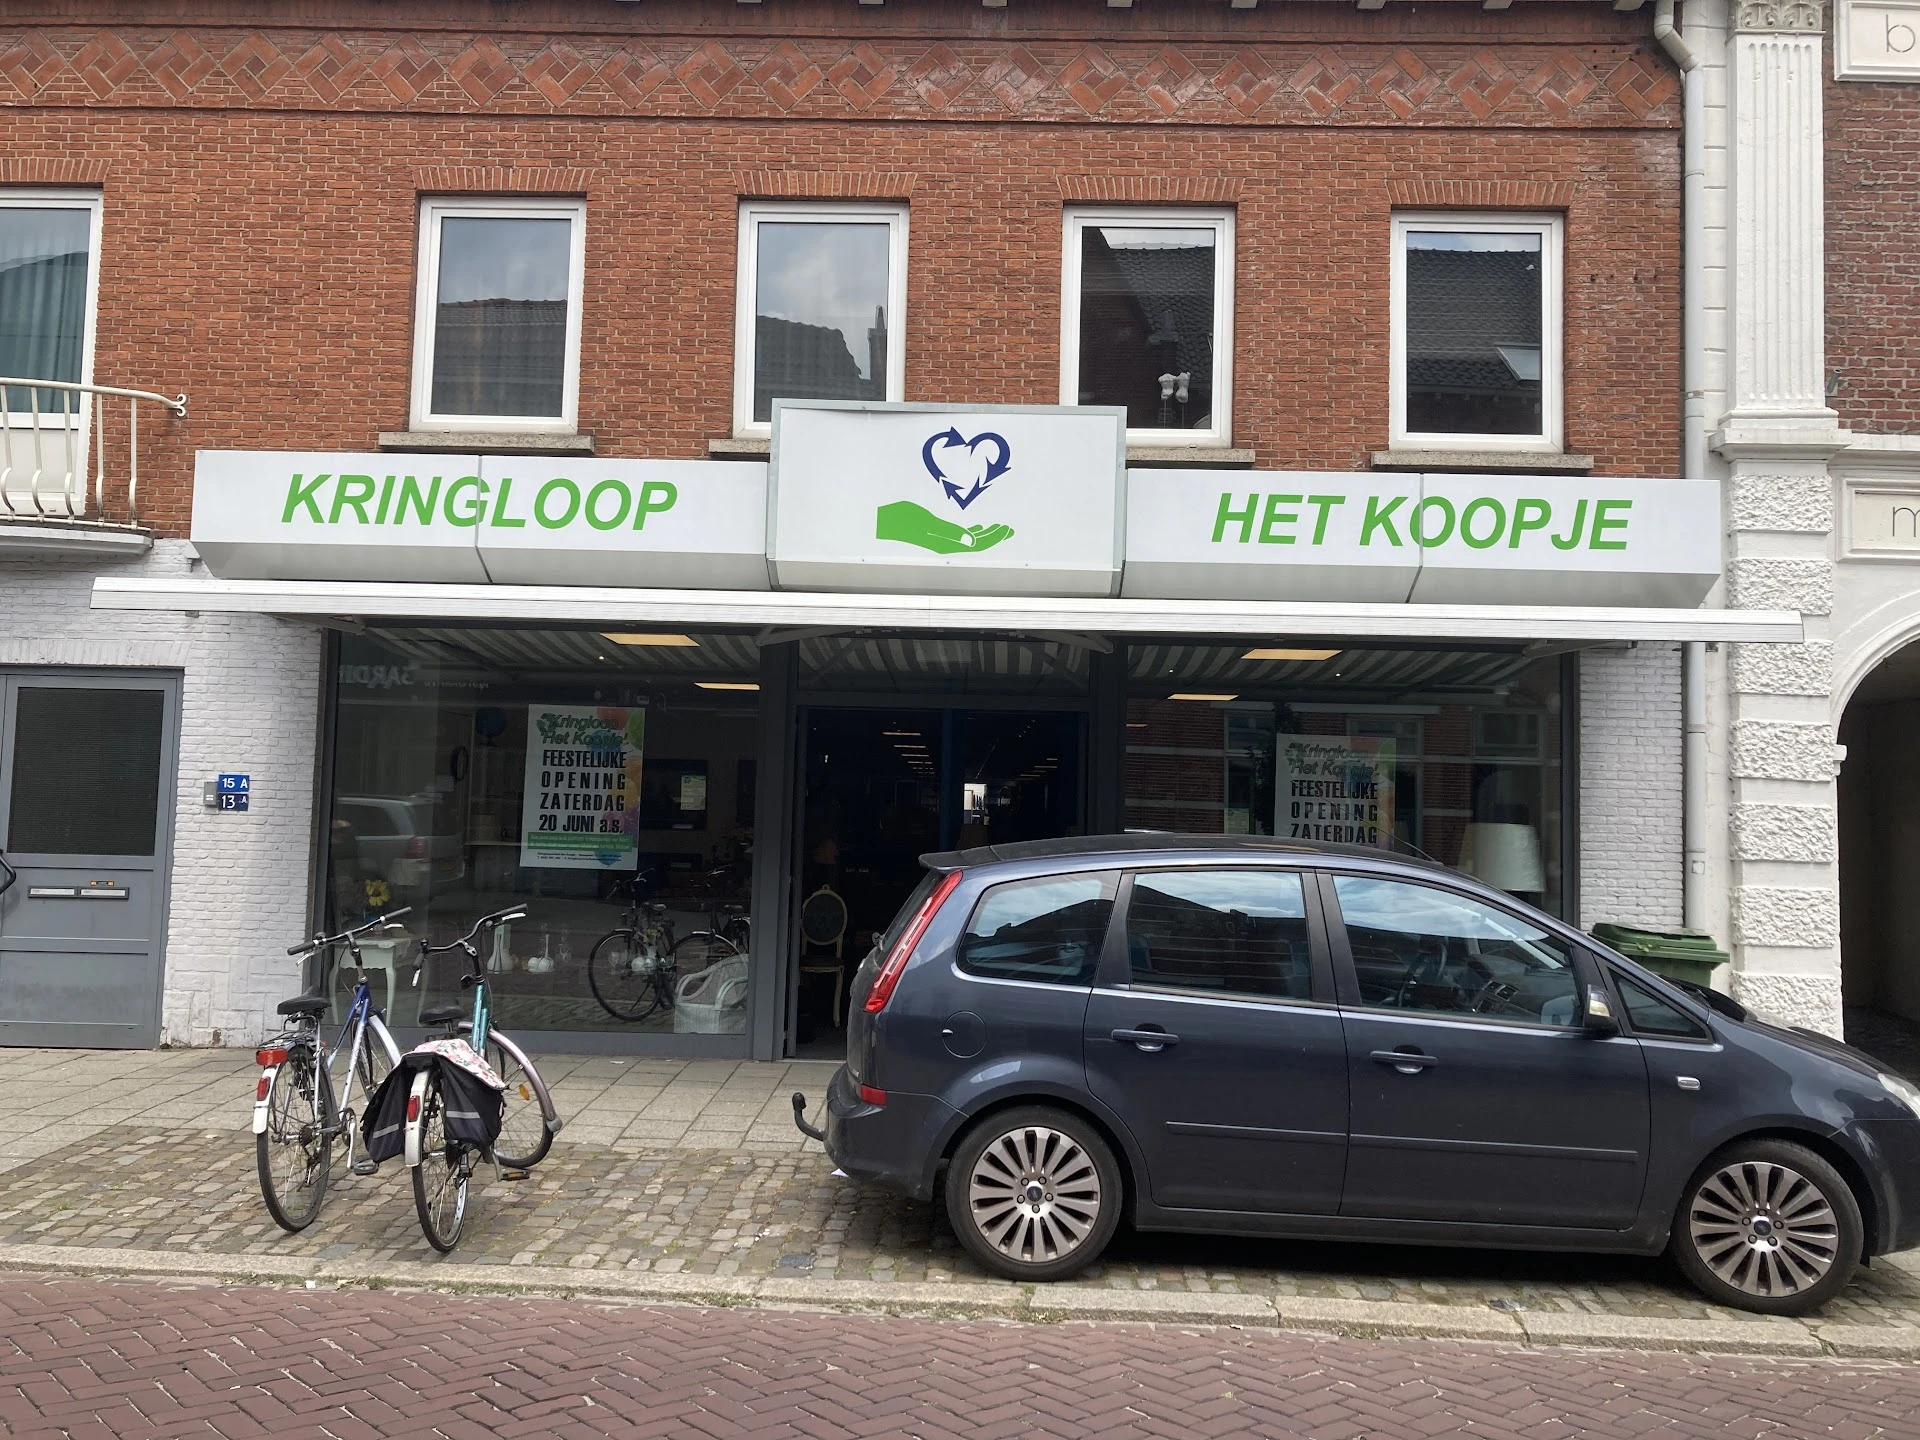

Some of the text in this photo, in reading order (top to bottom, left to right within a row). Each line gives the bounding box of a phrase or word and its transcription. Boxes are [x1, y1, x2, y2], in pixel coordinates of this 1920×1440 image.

[281, 473, 678, 531] KRINGLOOP
[1211, 492, 1633, 550] HET KOOPJE
[549, 714, 619, 732] Kringloop
[543, 750, 627, 768] FEESTELIJKE
[1298, 744, 1369, 762] Kringloop
[222, 778, 248, 788] 15 A
[541, 771, 626, 790] OPENING
[1291, 780, 1378, 800] FEESTELIJKE
[222, 795, 236, 808] 13
[540, 793, 625, 812] ZATERDAG
[1291, 801, 1378, 822] OPENING
[539, 814, 623, 833] 20 JUNI a.s.
[1291, 823, 1377, 844] ZATERDAG
